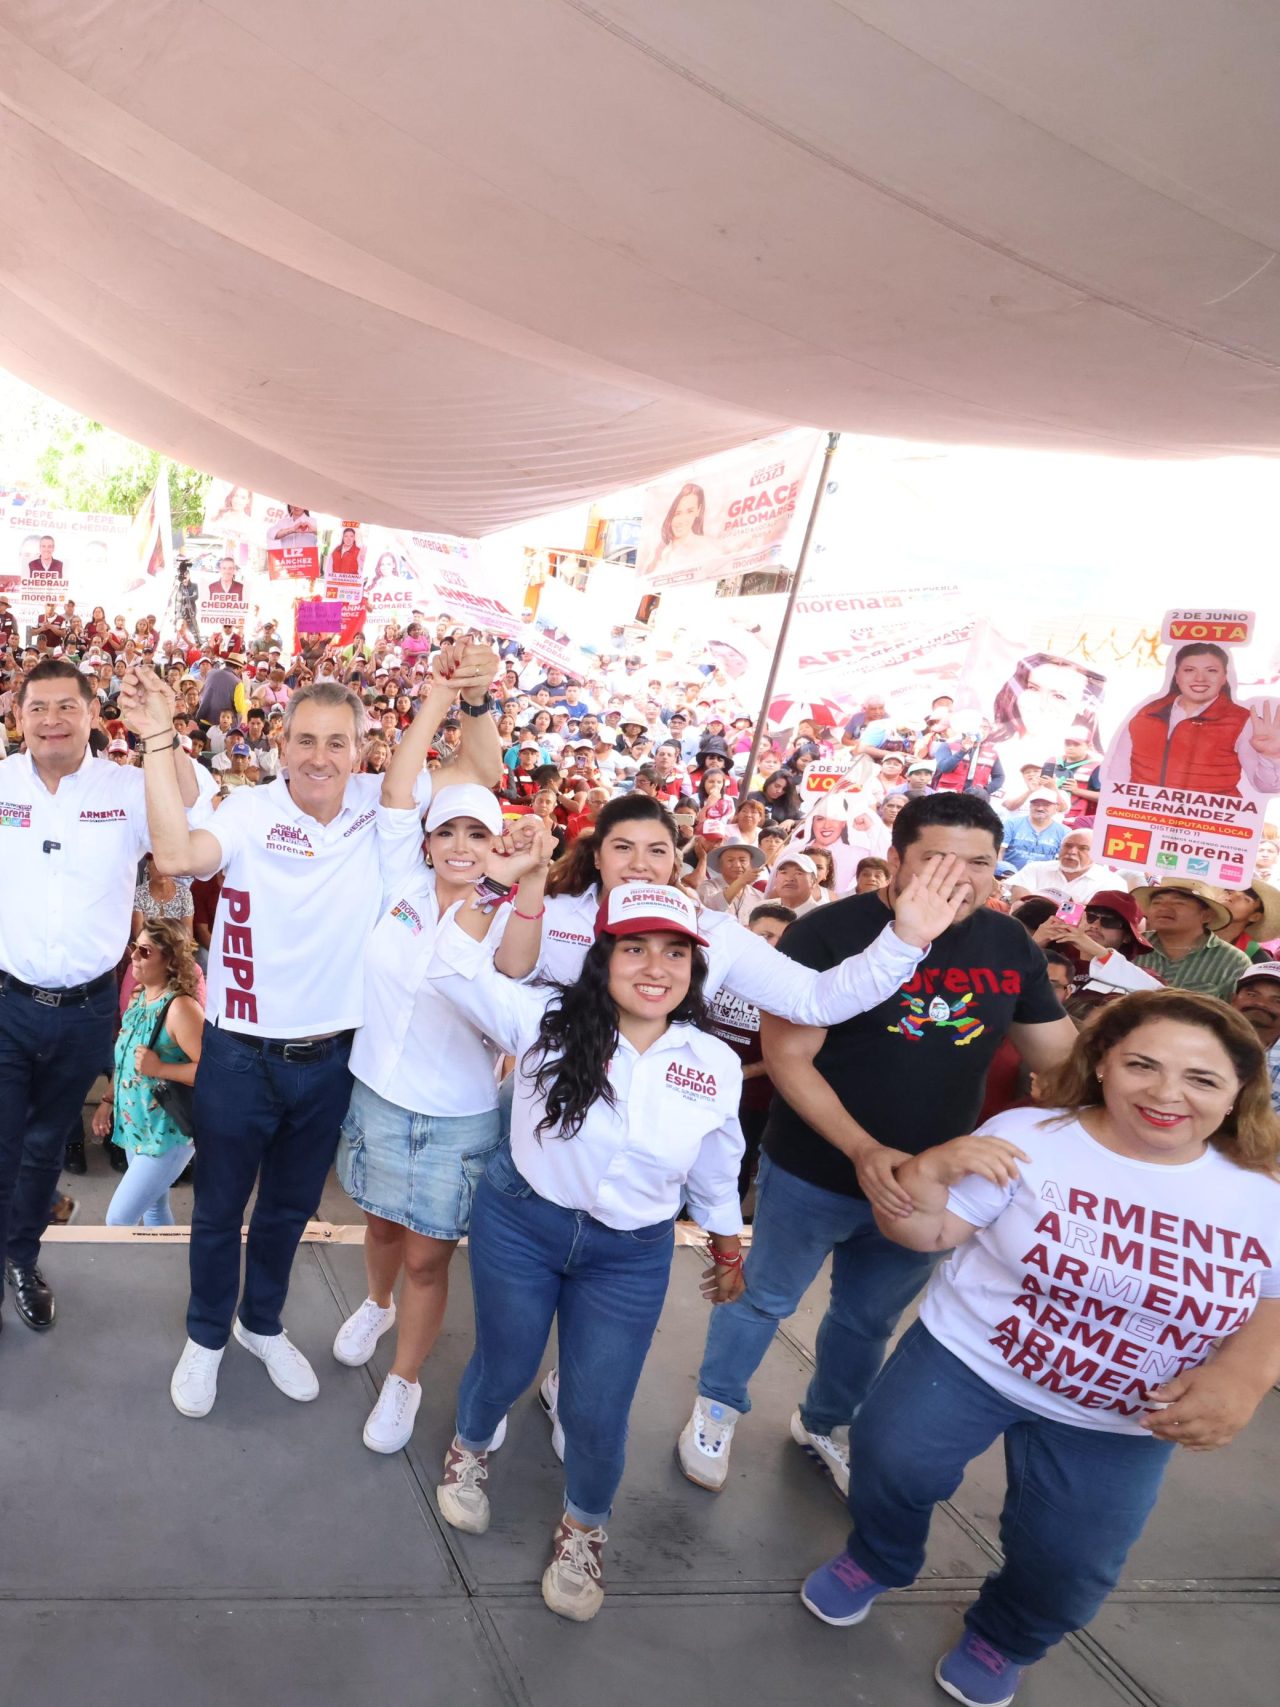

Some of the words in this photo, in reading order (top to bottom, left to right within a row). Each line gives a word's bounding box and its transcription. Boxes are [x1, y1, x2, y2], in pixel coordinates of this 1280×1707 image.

[728, 480, 800, 518] GRACE
[25, 509, 54, 519] PEPE
[87, 514, 115, 524] PEPE
[724, 500, 796, 531] PALOMARES
[9, 517, 67, 530] CHEDRAUI
[72, 523, 128, 535] CHEDRAUI
[283, 548, 303, 558] LIZ
[21, 579, 69, 587] CHEDRAUI
[21, 594, 57, 602] morena
[373, 591, 413, 602] RACE
[433, 584, 513, 615] ARMENTA
[201, 601, 249, 610] CHEDRAUI
[373, 602, 413, 610] LOMARES
[201, 616, 237, 625] morena
[1172, 611, 1180, 620] 2
[1183, 612, 1202, 621] DE
[1204, 612, 1249, 622] JUNIO
[1171, 624, 1248, 640] VOTA
[810, 765, 816, 774] 2
[818, 765, 832, 774] DE
[1112, 783, 1150, 798] XEL
[1154, 788, 1259, 815] ARIANNA
[79, 809, 126, 819] ARMENTA
[1128, 798, 1236, 824] HERNÁNDEZ
[275, 823, 291, 832] POR
[292, 826, 302, 834] LA
[343, 809, 377, 838] CHEDRAUI
[1106, 808, 1156, 823] CANDIDATA
[1159, 816, 1167, 824] A
[1168, 818, 1216, 833] DIPUTADA
[1218, 826, 1251, 838] LOCAL
[1149, 824, 1192, 836] DISTRITO
[270, 828, 309, 842] PUEBLA
[266, 842, 304, 856] morena
[1106, 839, 1146, 861] PT
[1160, 840, 1245, 865] morena
[622, 893, 689, 913] ARMENTA
[397, 900, 424, 931] morena
[549, 928, 591, 944] morena
[221, 887, 258, 1024] PEPE
[667, 1061, 716, 1087] ALEXA
[665, 1073, 717, 1097] ESPIDIO
[1041, 1180, 1272, 1268] ARMENTA
[1034, 1210, 1257, 1300] ARMENTA
[1021, 1243, 1250, 1332] ARMENTA
[1021, 1273, 1218, 1355] ARMENT
